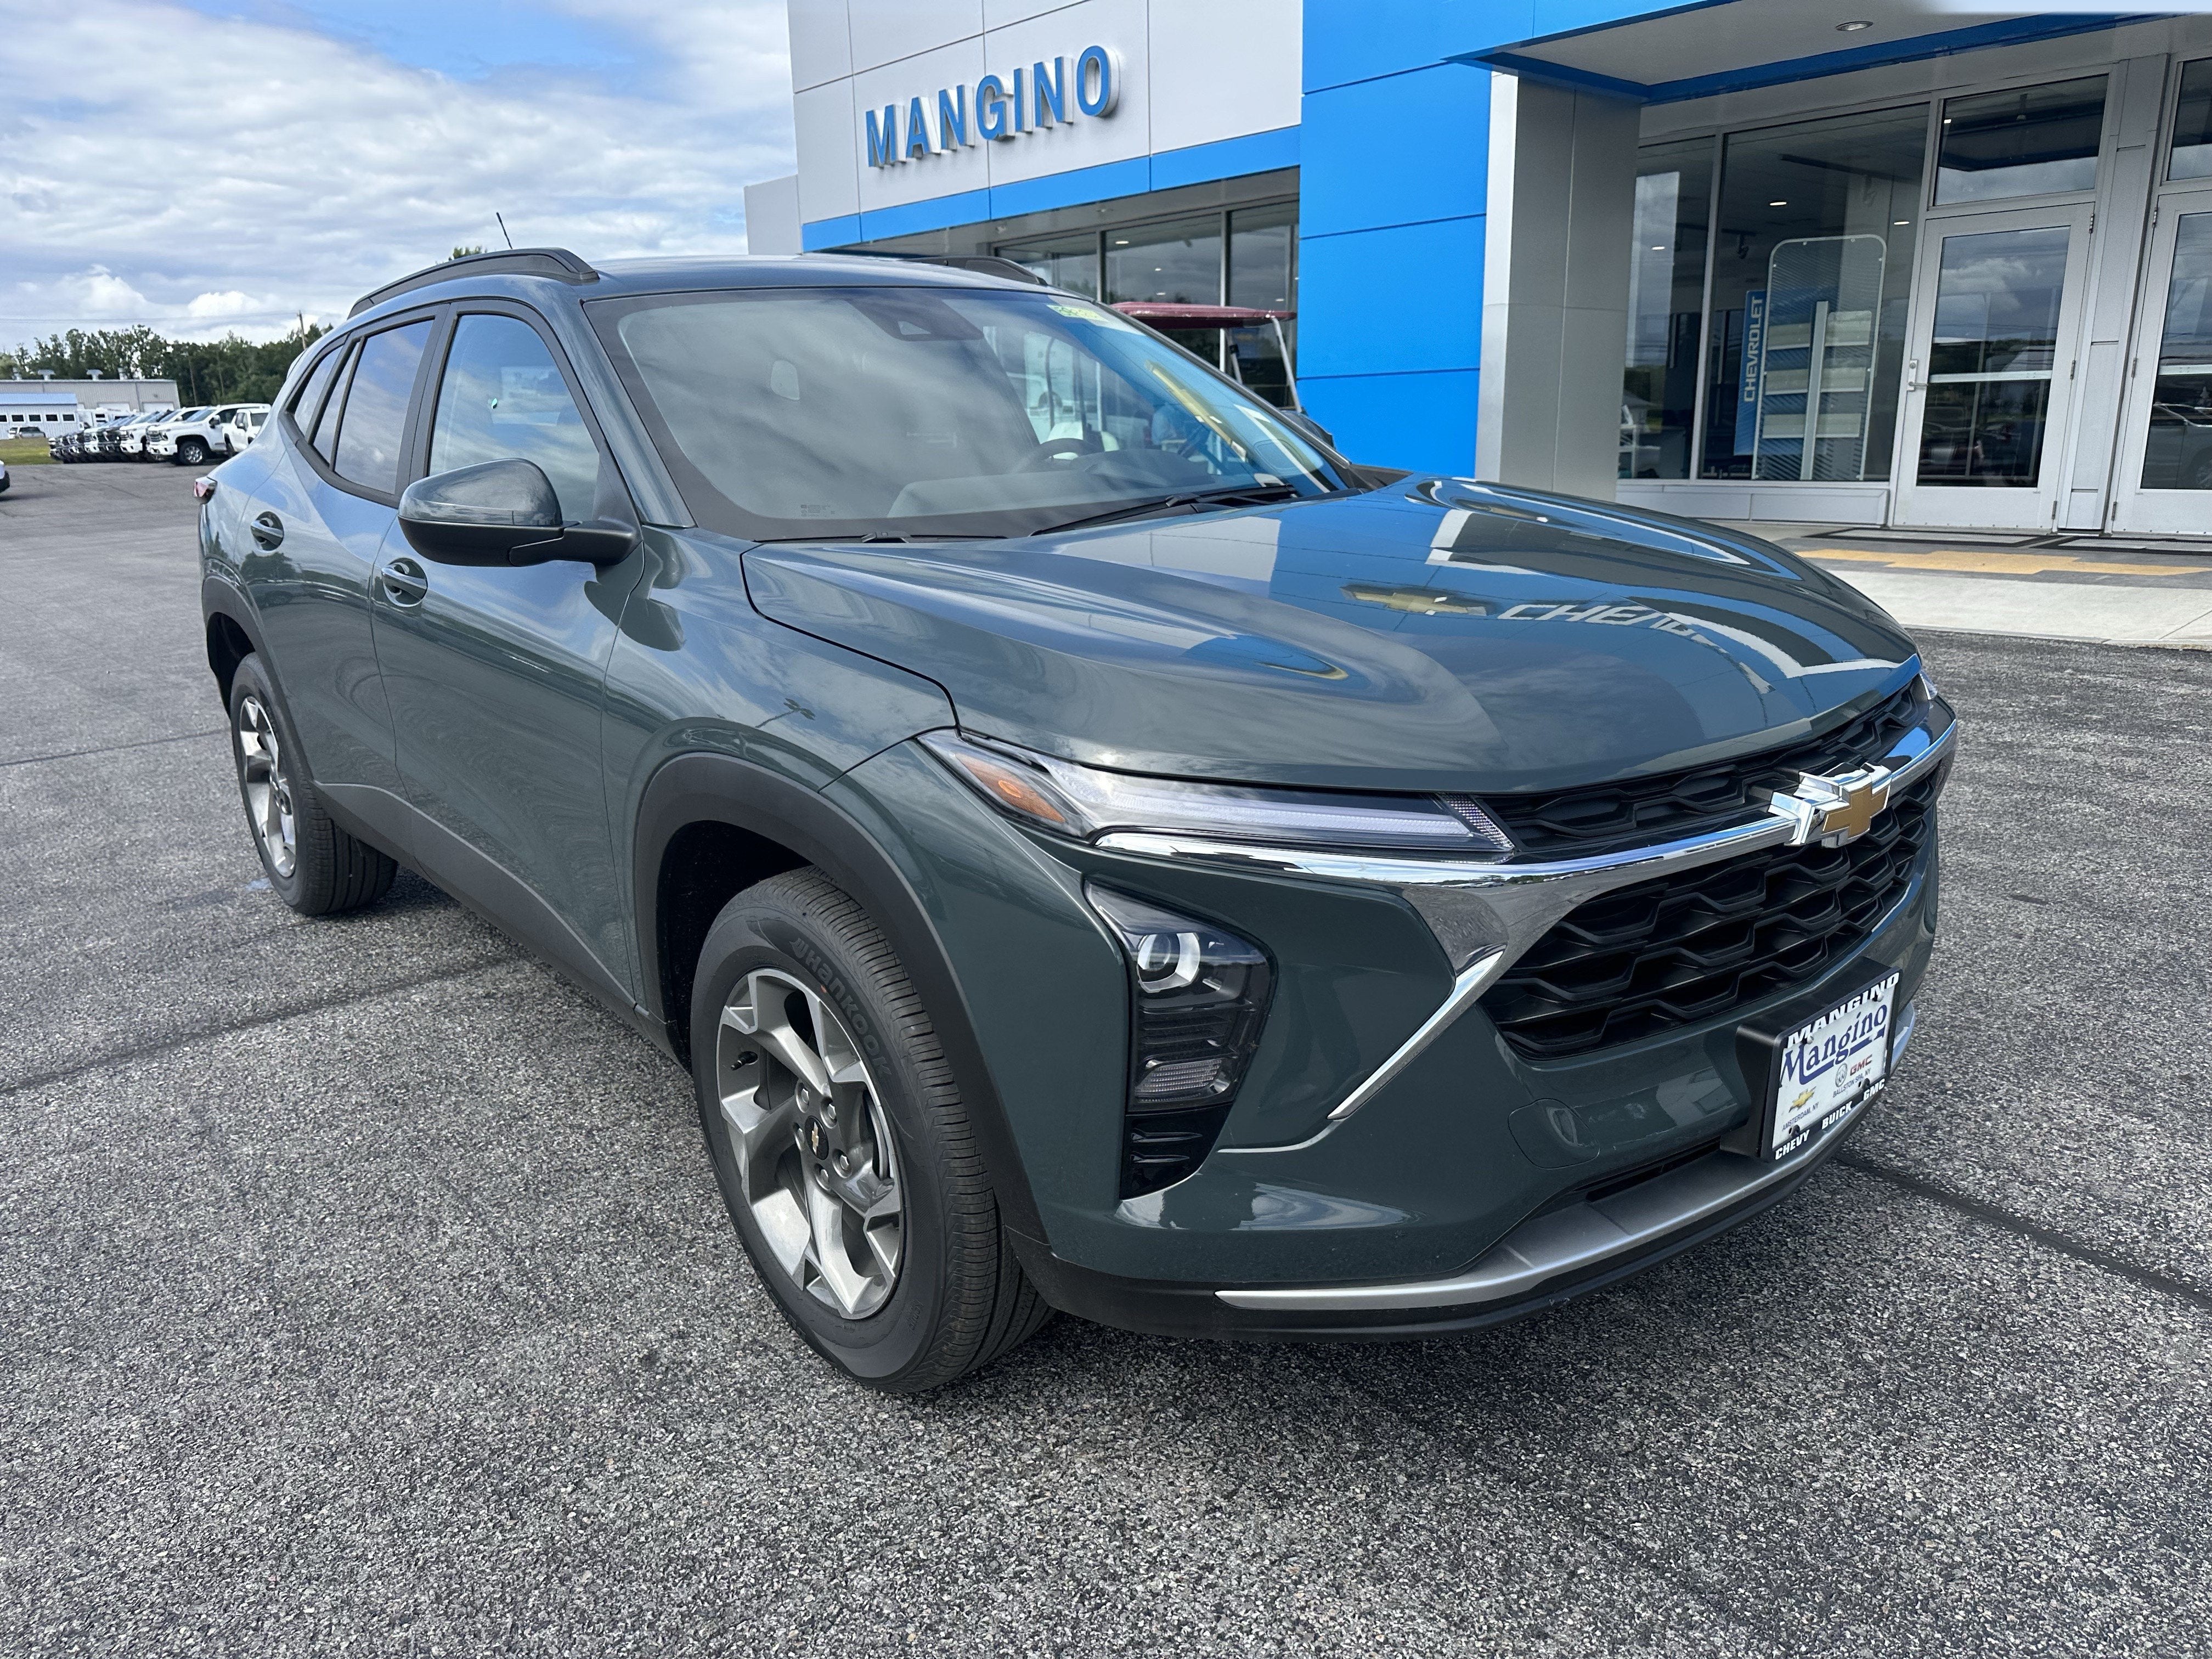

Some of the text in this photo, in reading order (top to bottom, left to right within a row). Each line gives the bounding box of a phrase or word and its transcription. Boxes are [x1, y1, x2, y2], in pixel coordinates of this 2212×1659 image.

[866, 45, 1120, 168] MANGINO
[1744, 296, 1763, 402] CHEVROLET
[1780, 1005, 1887, 1086] Mangino
[1787, 972, 1899, 1049] MANGINO
[1850, 1054, 1872, 1076] GMC
[1775, 1079, 1886, 1160] CHEVY BUICK GMC
[1813, 1102, 1819, 1111] NY
